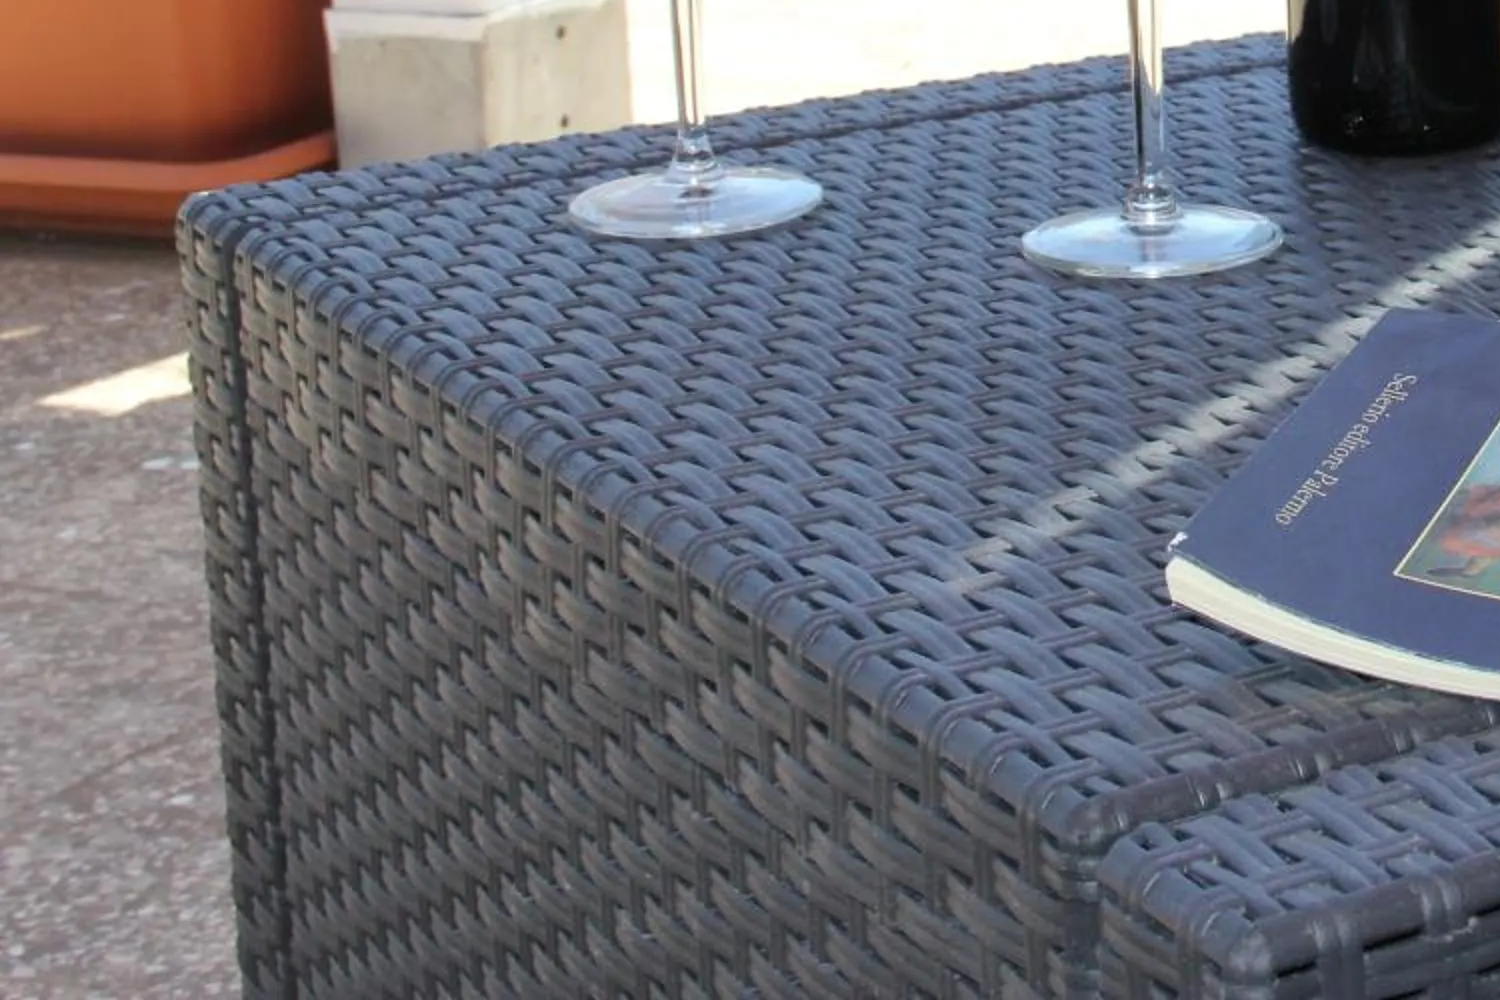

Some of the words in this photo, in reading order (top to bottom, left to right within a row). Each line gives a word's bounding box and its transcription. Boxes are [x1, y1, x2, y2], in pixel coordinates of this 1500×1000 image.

[1361, 373, 1417, 423] Sellerio
[1321, 423, 1372, 471] editore
[1275, 468, 1340, 525] Palermo
